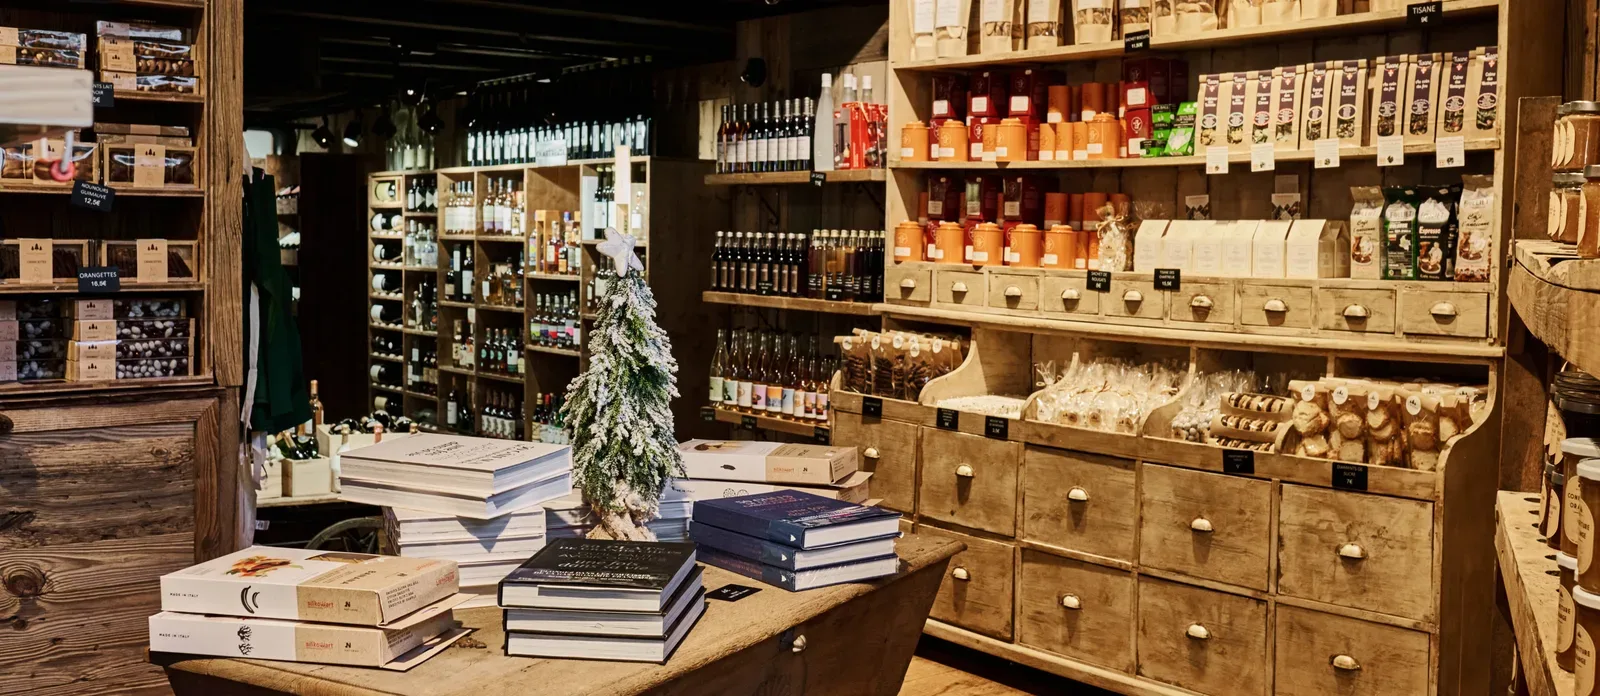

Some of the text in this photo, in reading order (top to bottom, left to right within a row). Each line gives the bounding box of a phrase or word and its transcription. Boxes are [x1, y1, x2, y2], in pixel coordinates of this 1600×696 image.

[1412, 4, 1436, 14] TISANE
[81, 183, 108, 193] NOUNOURS
[80, 189, 107, 200] GUIMAUVE
[1418, 226, 1441, 235] Espresso
